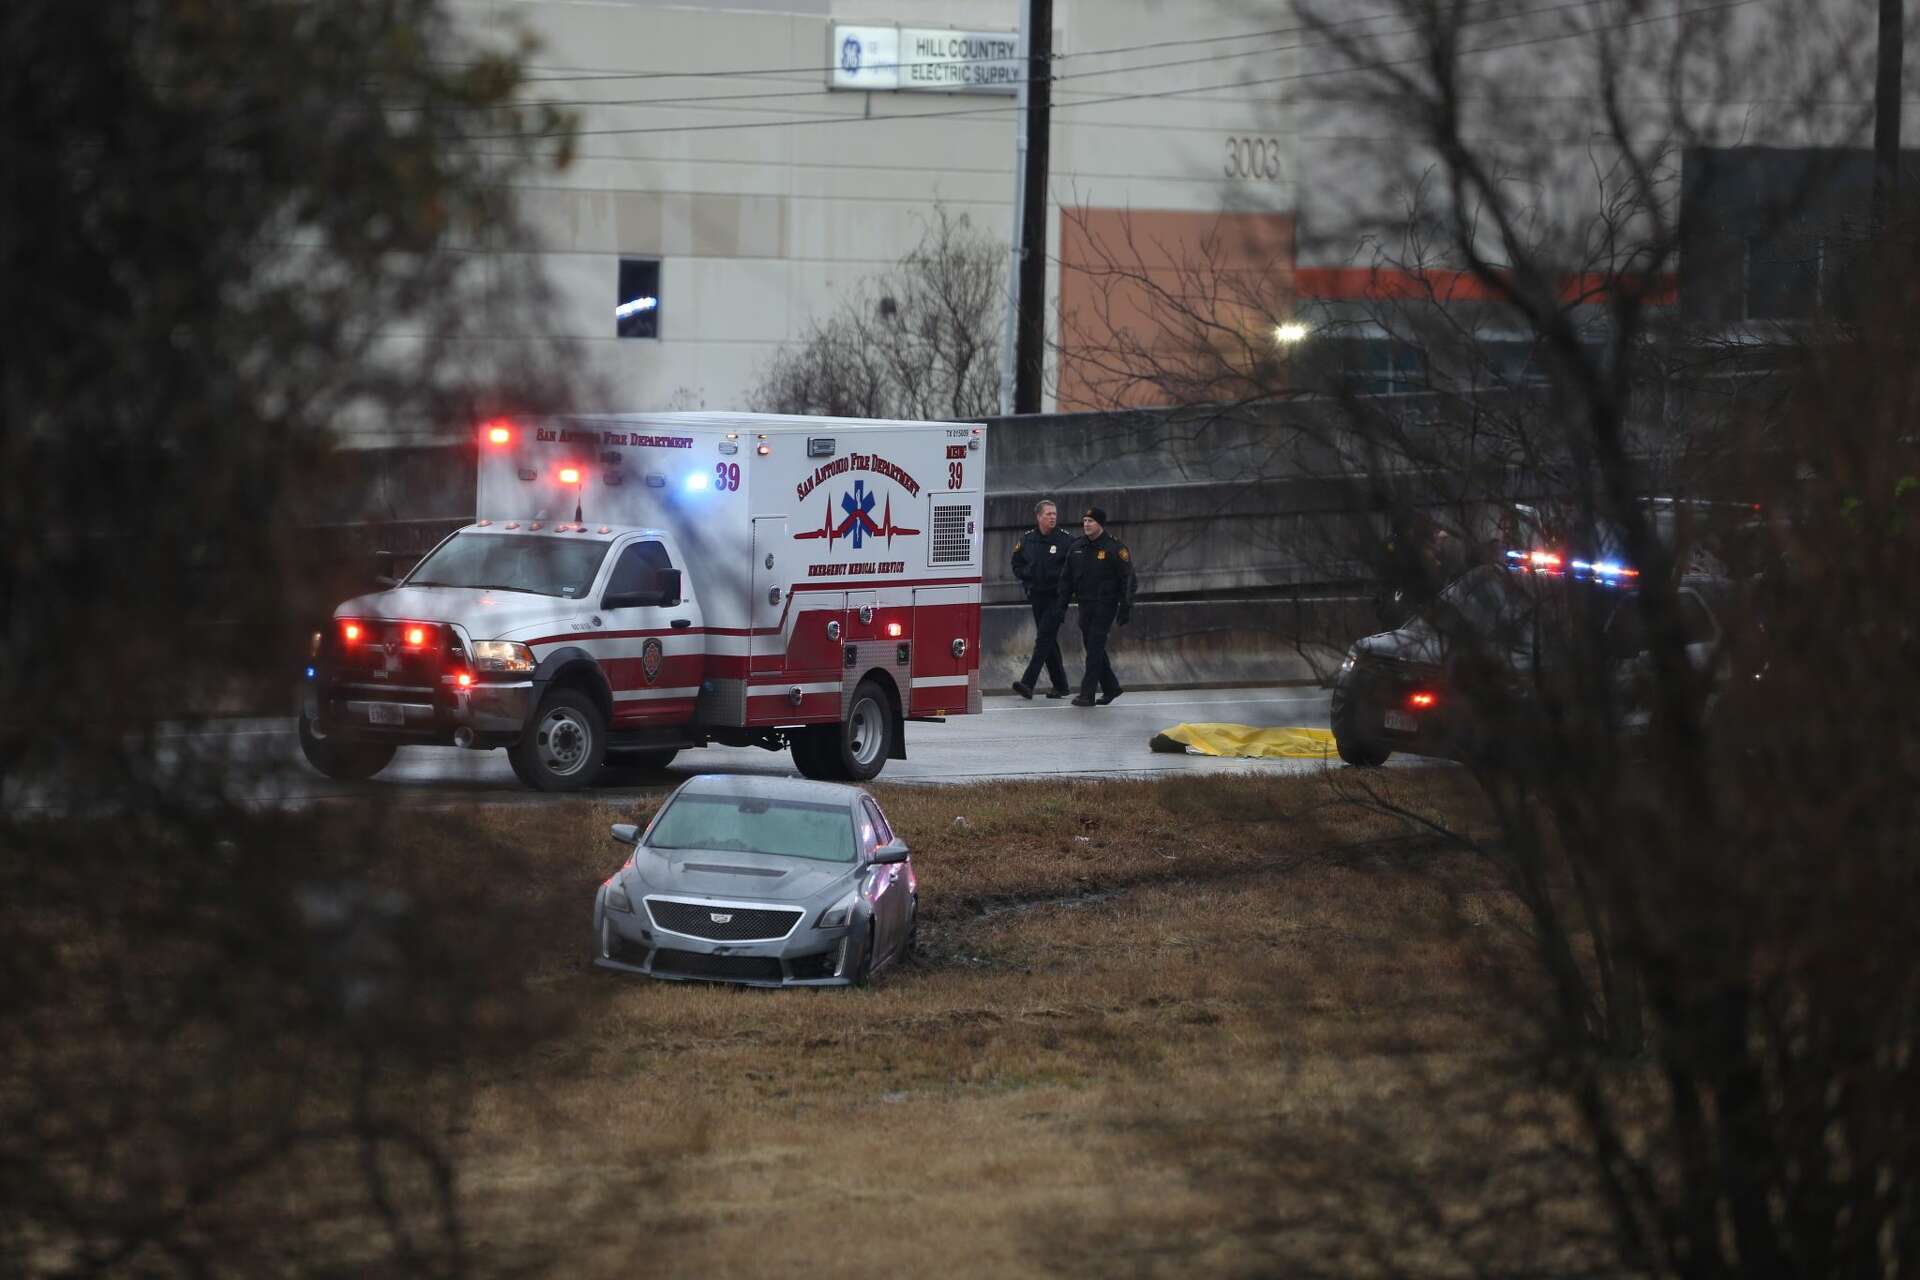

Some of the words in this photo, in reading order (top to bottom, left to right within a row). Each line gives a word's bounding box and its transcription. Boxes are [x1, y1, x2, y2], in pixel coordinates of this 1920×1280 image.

[916, 40, 946, 58] HILL
[949, 40, 1015, 60] COUNTRY
[911, 64, 970, 82] ELECTRIC
[974, 65, 1019, 83] SUPPLY
[1224, 137, 1280, 180] 3003
[536, 427, 556, 442] SAN
[603, 431, 628, 446] FIRE
[630, 432, 694, 448] DEPARTMENT
[715, 462, 740, 492] 39
[797, 475, 815, 502] SAN
[815, 456, 849, 488] ANTONIO
[850, 452, 870, 471] FIRE
[871, 453, 921, 498] DEPARTMENT
[948, 461, 963, 490] 39
[808, 563, 847, 577] EMERGENCY
[848, 562, 876, 575] MEDICAL
[878, 561, 905, 574] SERVICE
